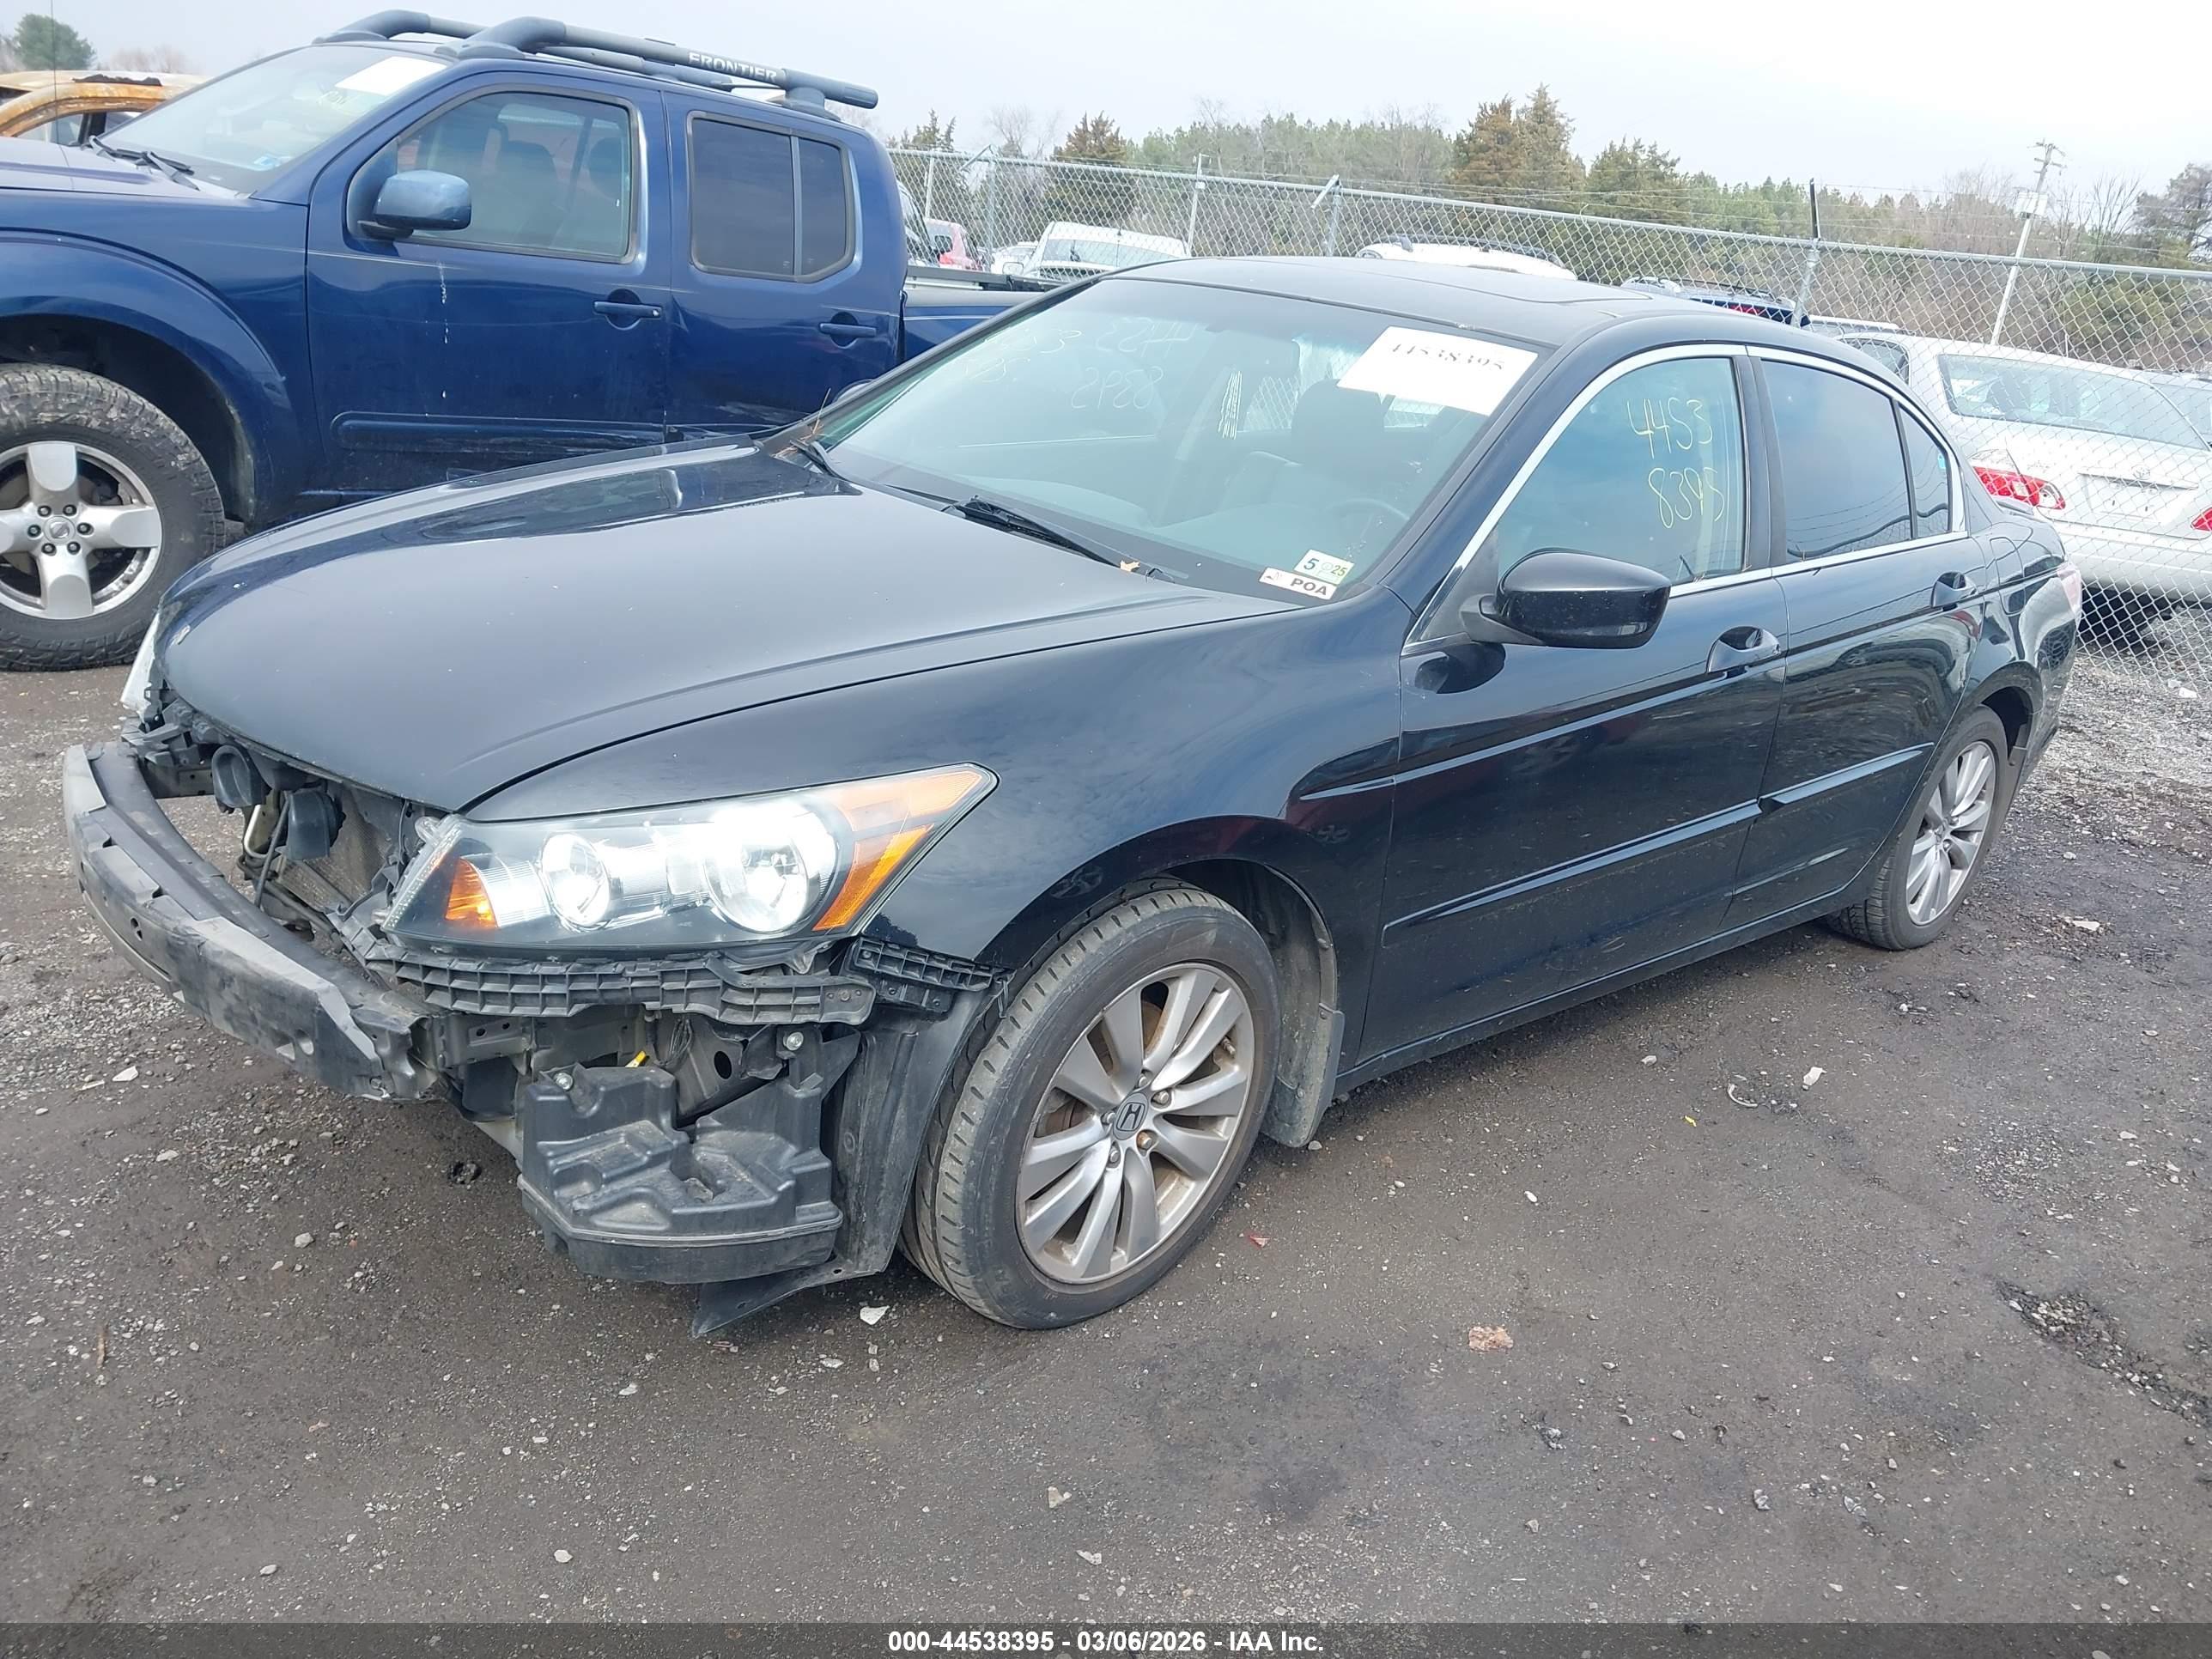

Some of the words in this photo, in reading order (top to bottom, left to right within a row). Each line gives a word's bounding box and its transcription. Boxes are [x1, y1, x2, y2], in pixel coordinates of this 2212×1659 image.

[688, 52, 778, 82] FRONTIER
[1626, 398, 1713, 459] 4453
[1647, 466, 1725, 529] 8395
[1303, 557, 1320, 570] 5
[1330, 564, 1348, 577] 25
[1290, 578, 1327, 596] POA
